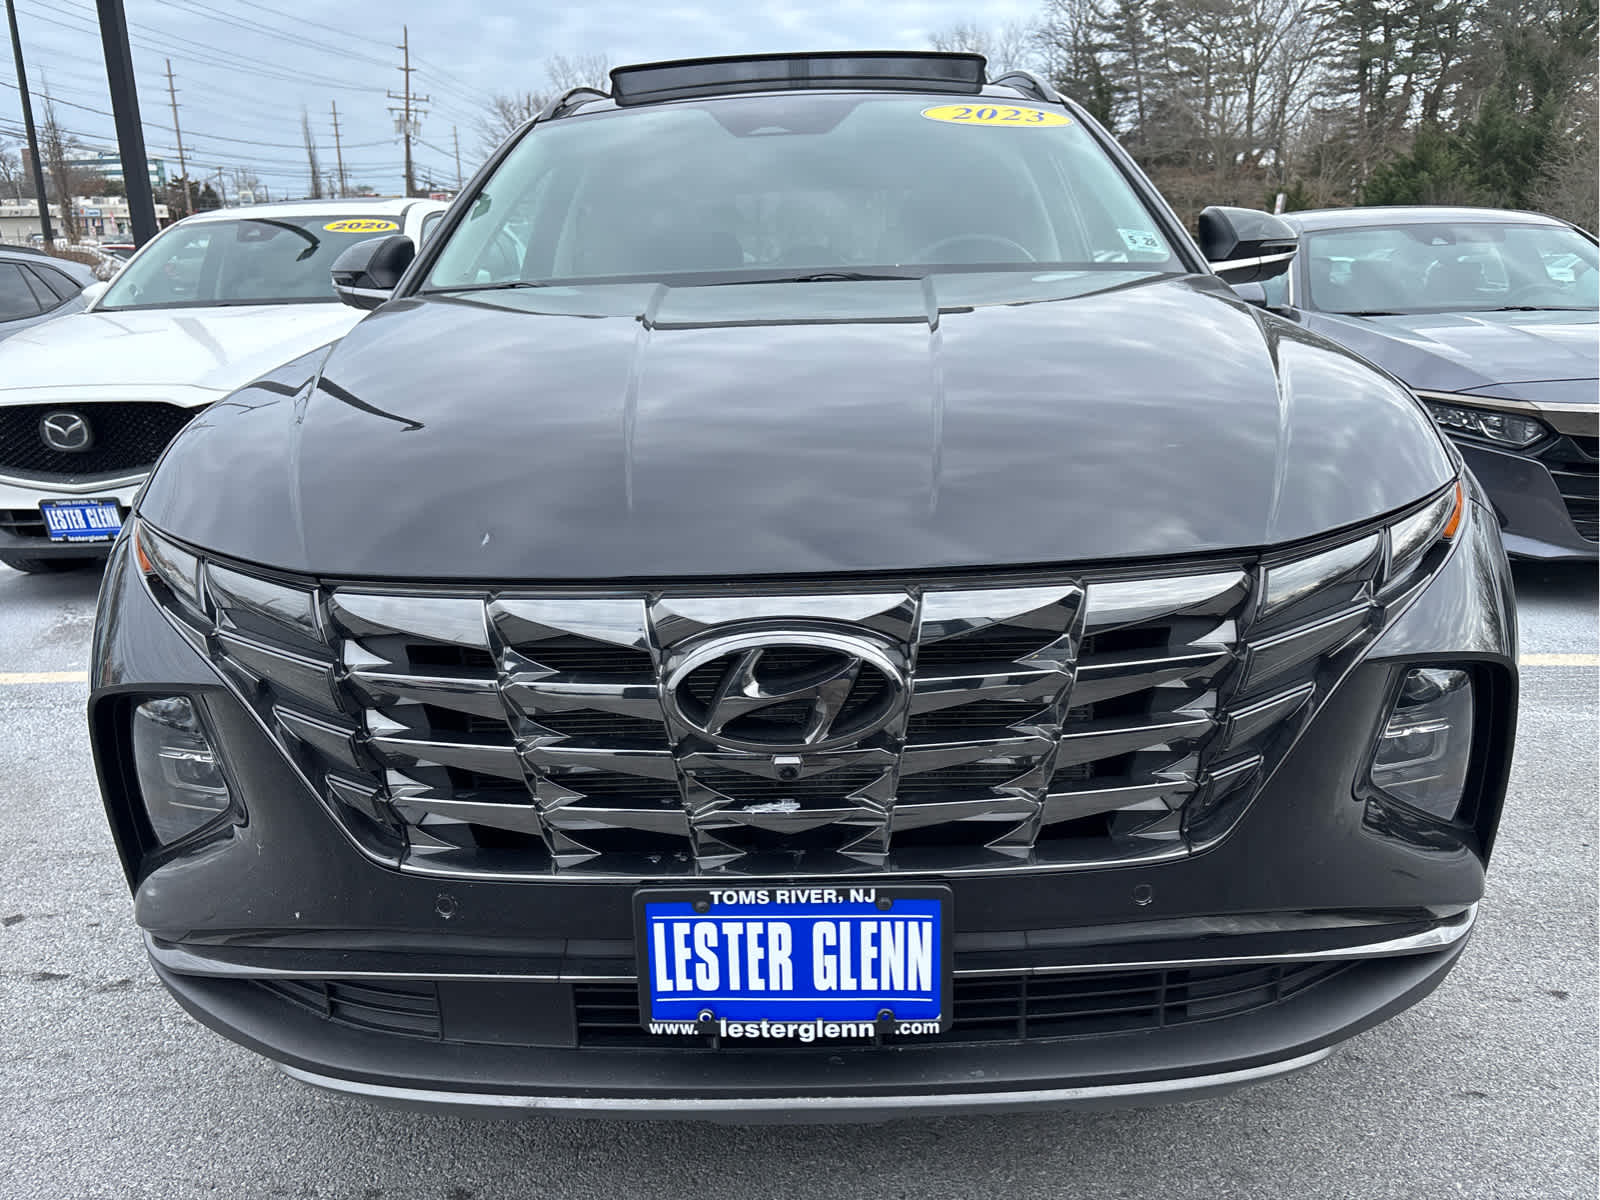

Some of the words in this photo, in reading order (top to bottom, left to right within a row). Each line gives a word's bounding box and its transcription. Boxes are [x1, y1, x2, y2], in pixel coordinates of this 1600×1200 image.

[952, 107, 1044, 122] 2023
[332, 222, 390, 230] 2020
[46, 509, 87, 530] LESTER
[85, 505, 121, 528] GLENN
[709, 890, 770, 904] TOMS
[776, 890, 843, 904] RIVER,
[850, 889, 876, 903] NJ
[653, 922, 793, 992] LESTER
[812, 921, 932, 991] GLENN
[649, 1022, 698, 1035] www.
[720, 1018, 875, 1042] lesterglenn
[895, 1021, 940, 1035] .com
